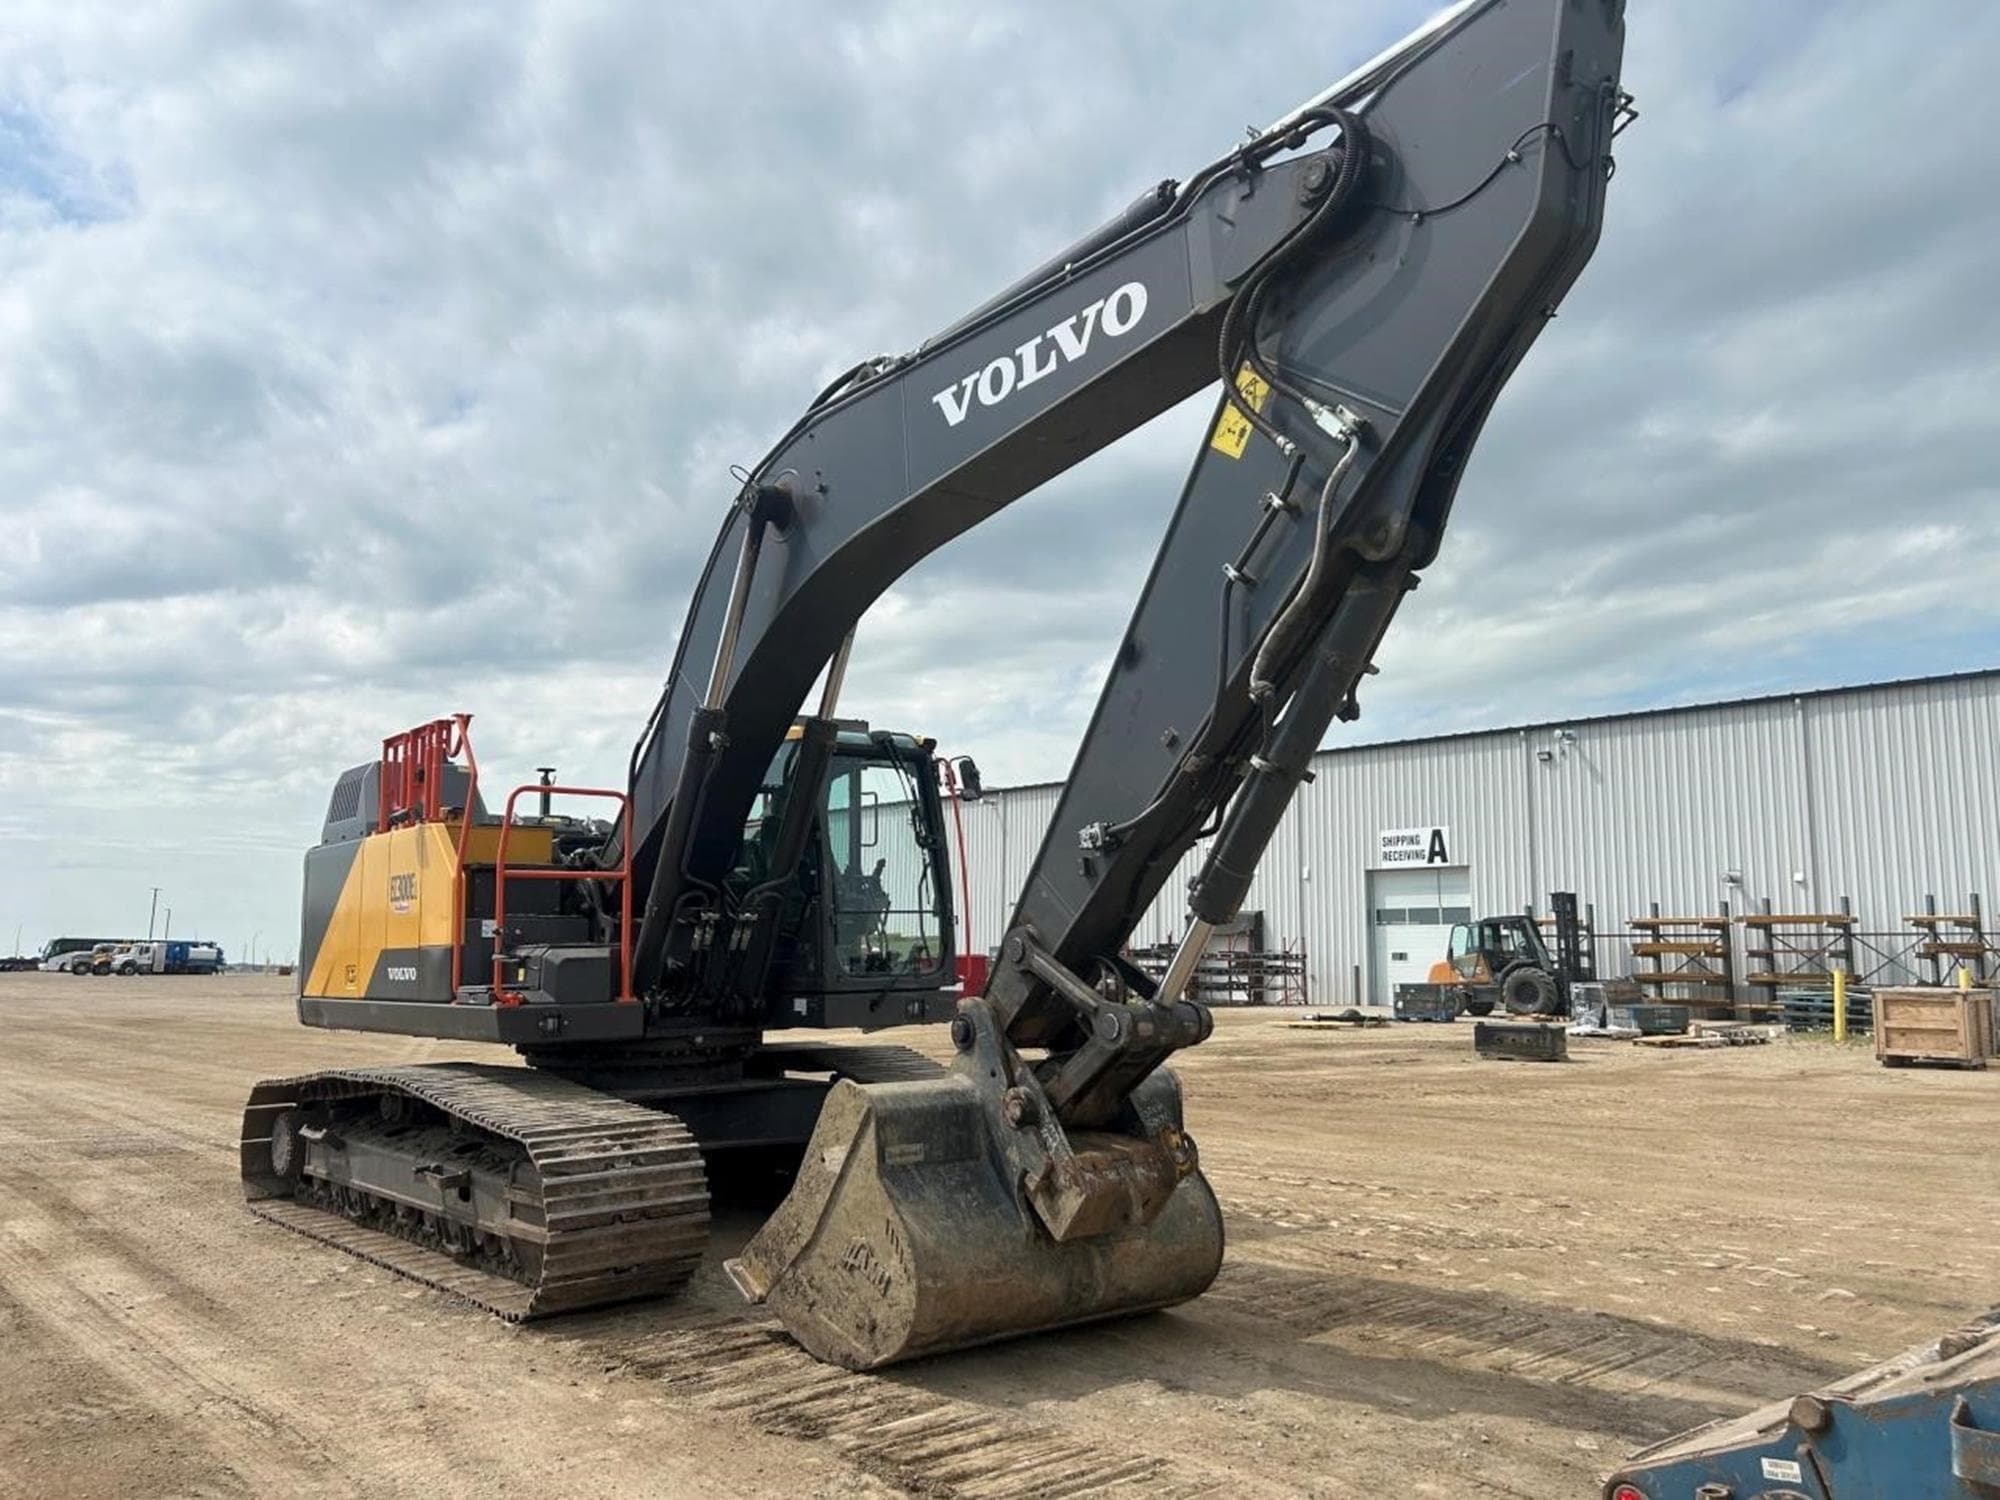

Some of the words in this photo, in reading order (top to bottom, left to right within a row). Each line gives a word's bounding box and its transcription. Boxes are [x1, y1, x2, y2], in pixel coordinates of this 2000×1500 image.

[932, 281, 1148, 427] VOLVO
[1382, 834, 1420, 847] SHIPPING
[1427, 829, 1449, 864] A
[1382, 849, 1426, 862] RECEIVING
[387, 966, 417, 981] VOLVO
